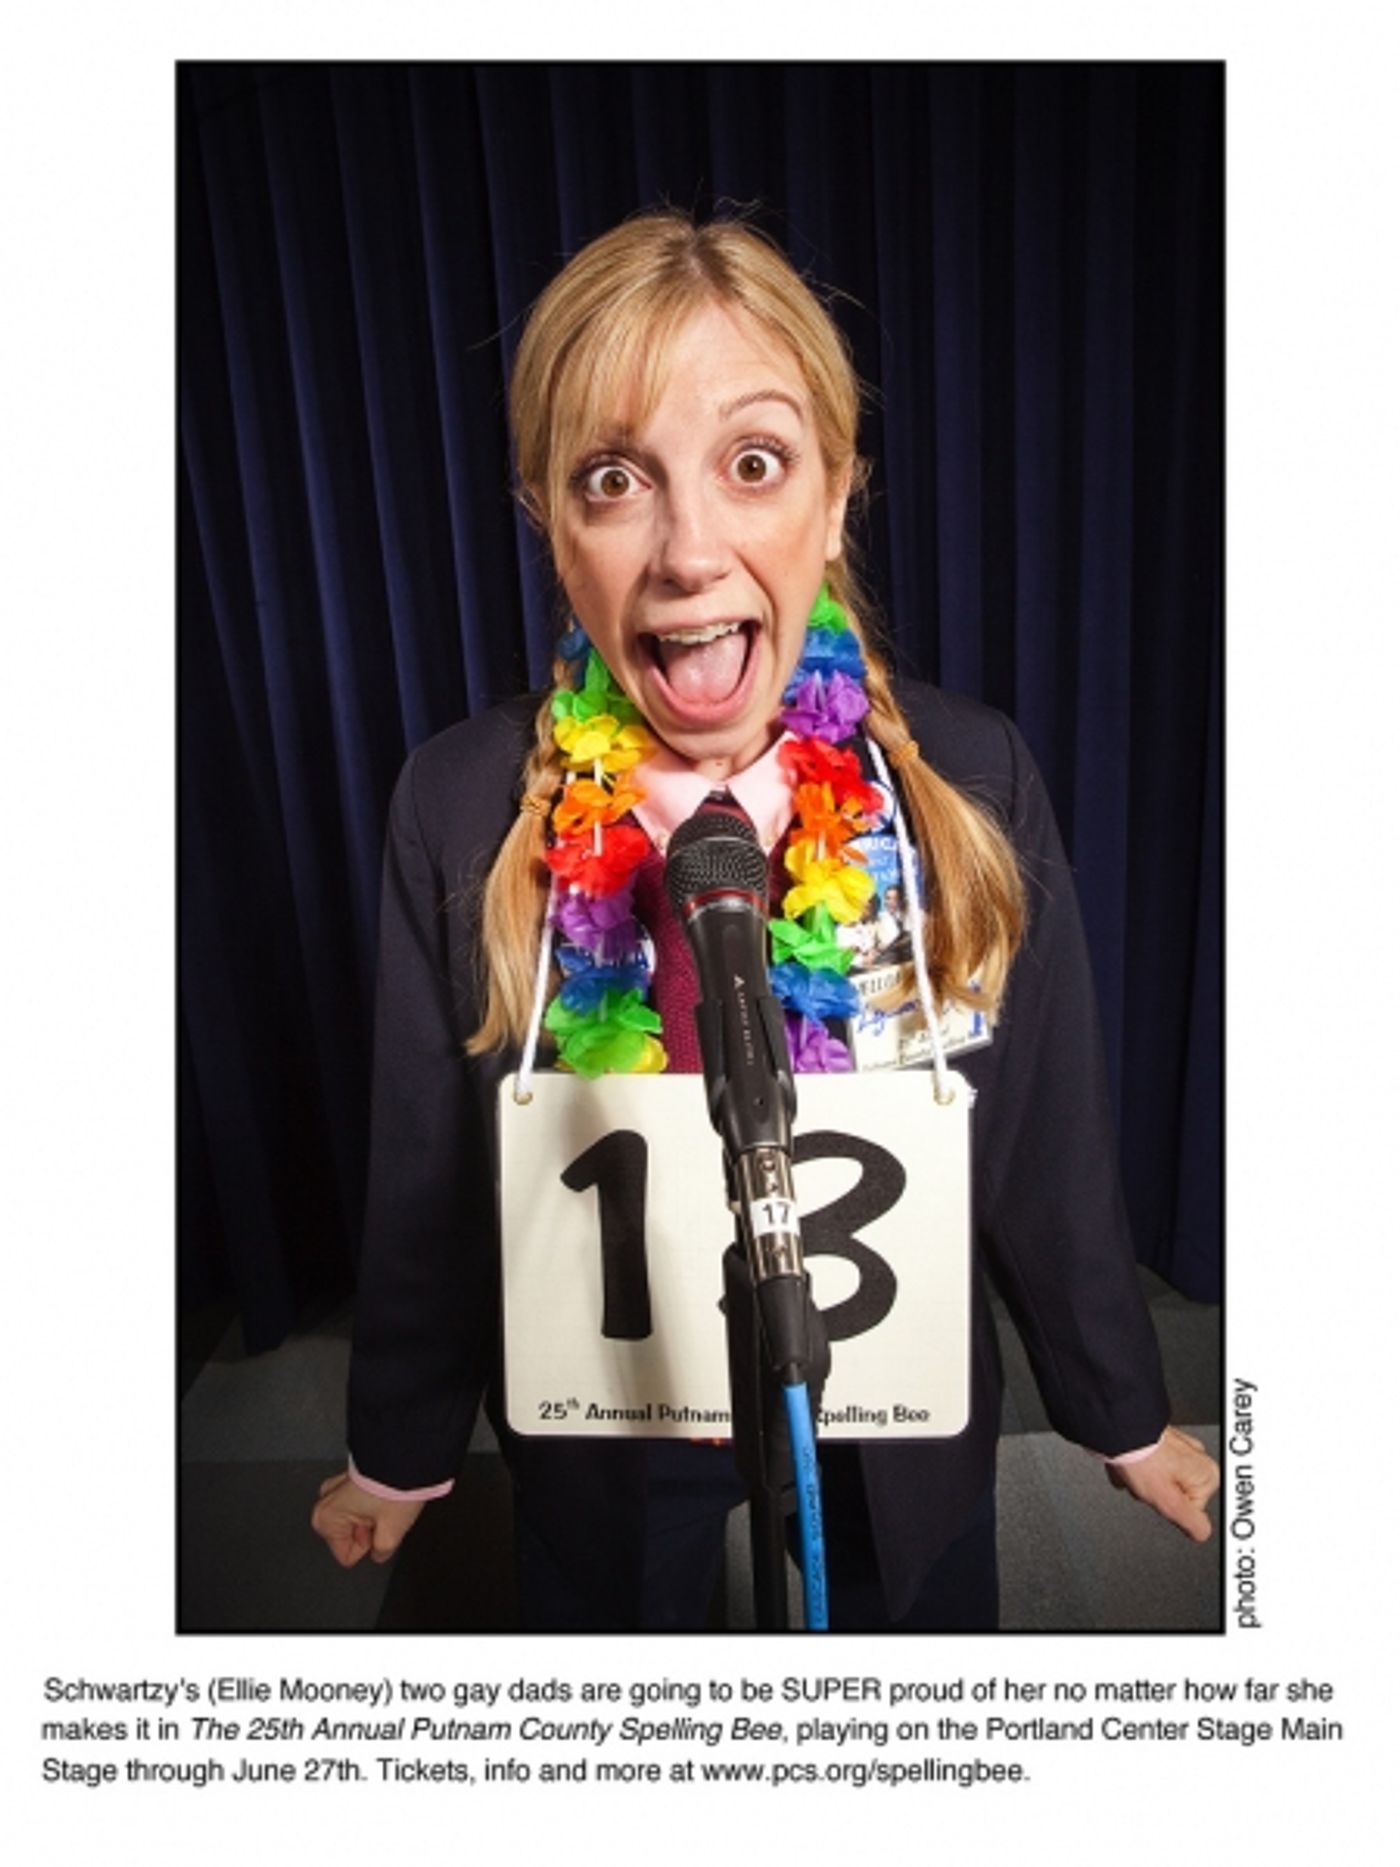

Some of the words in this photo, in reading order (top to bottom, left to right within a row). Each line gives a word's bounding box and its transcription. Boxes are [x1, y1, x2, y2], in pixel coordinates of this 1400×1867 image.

[762, 1200, 791, 1224] 17
[560, 1129, 907, 1342] 13
[539, 1398, 580, 1421] 25th
[584, 1403, 653, 1421] Annual
[658, 1404, 731, 1423] Putnam
[892, 1404, 930, 1422] Bee
